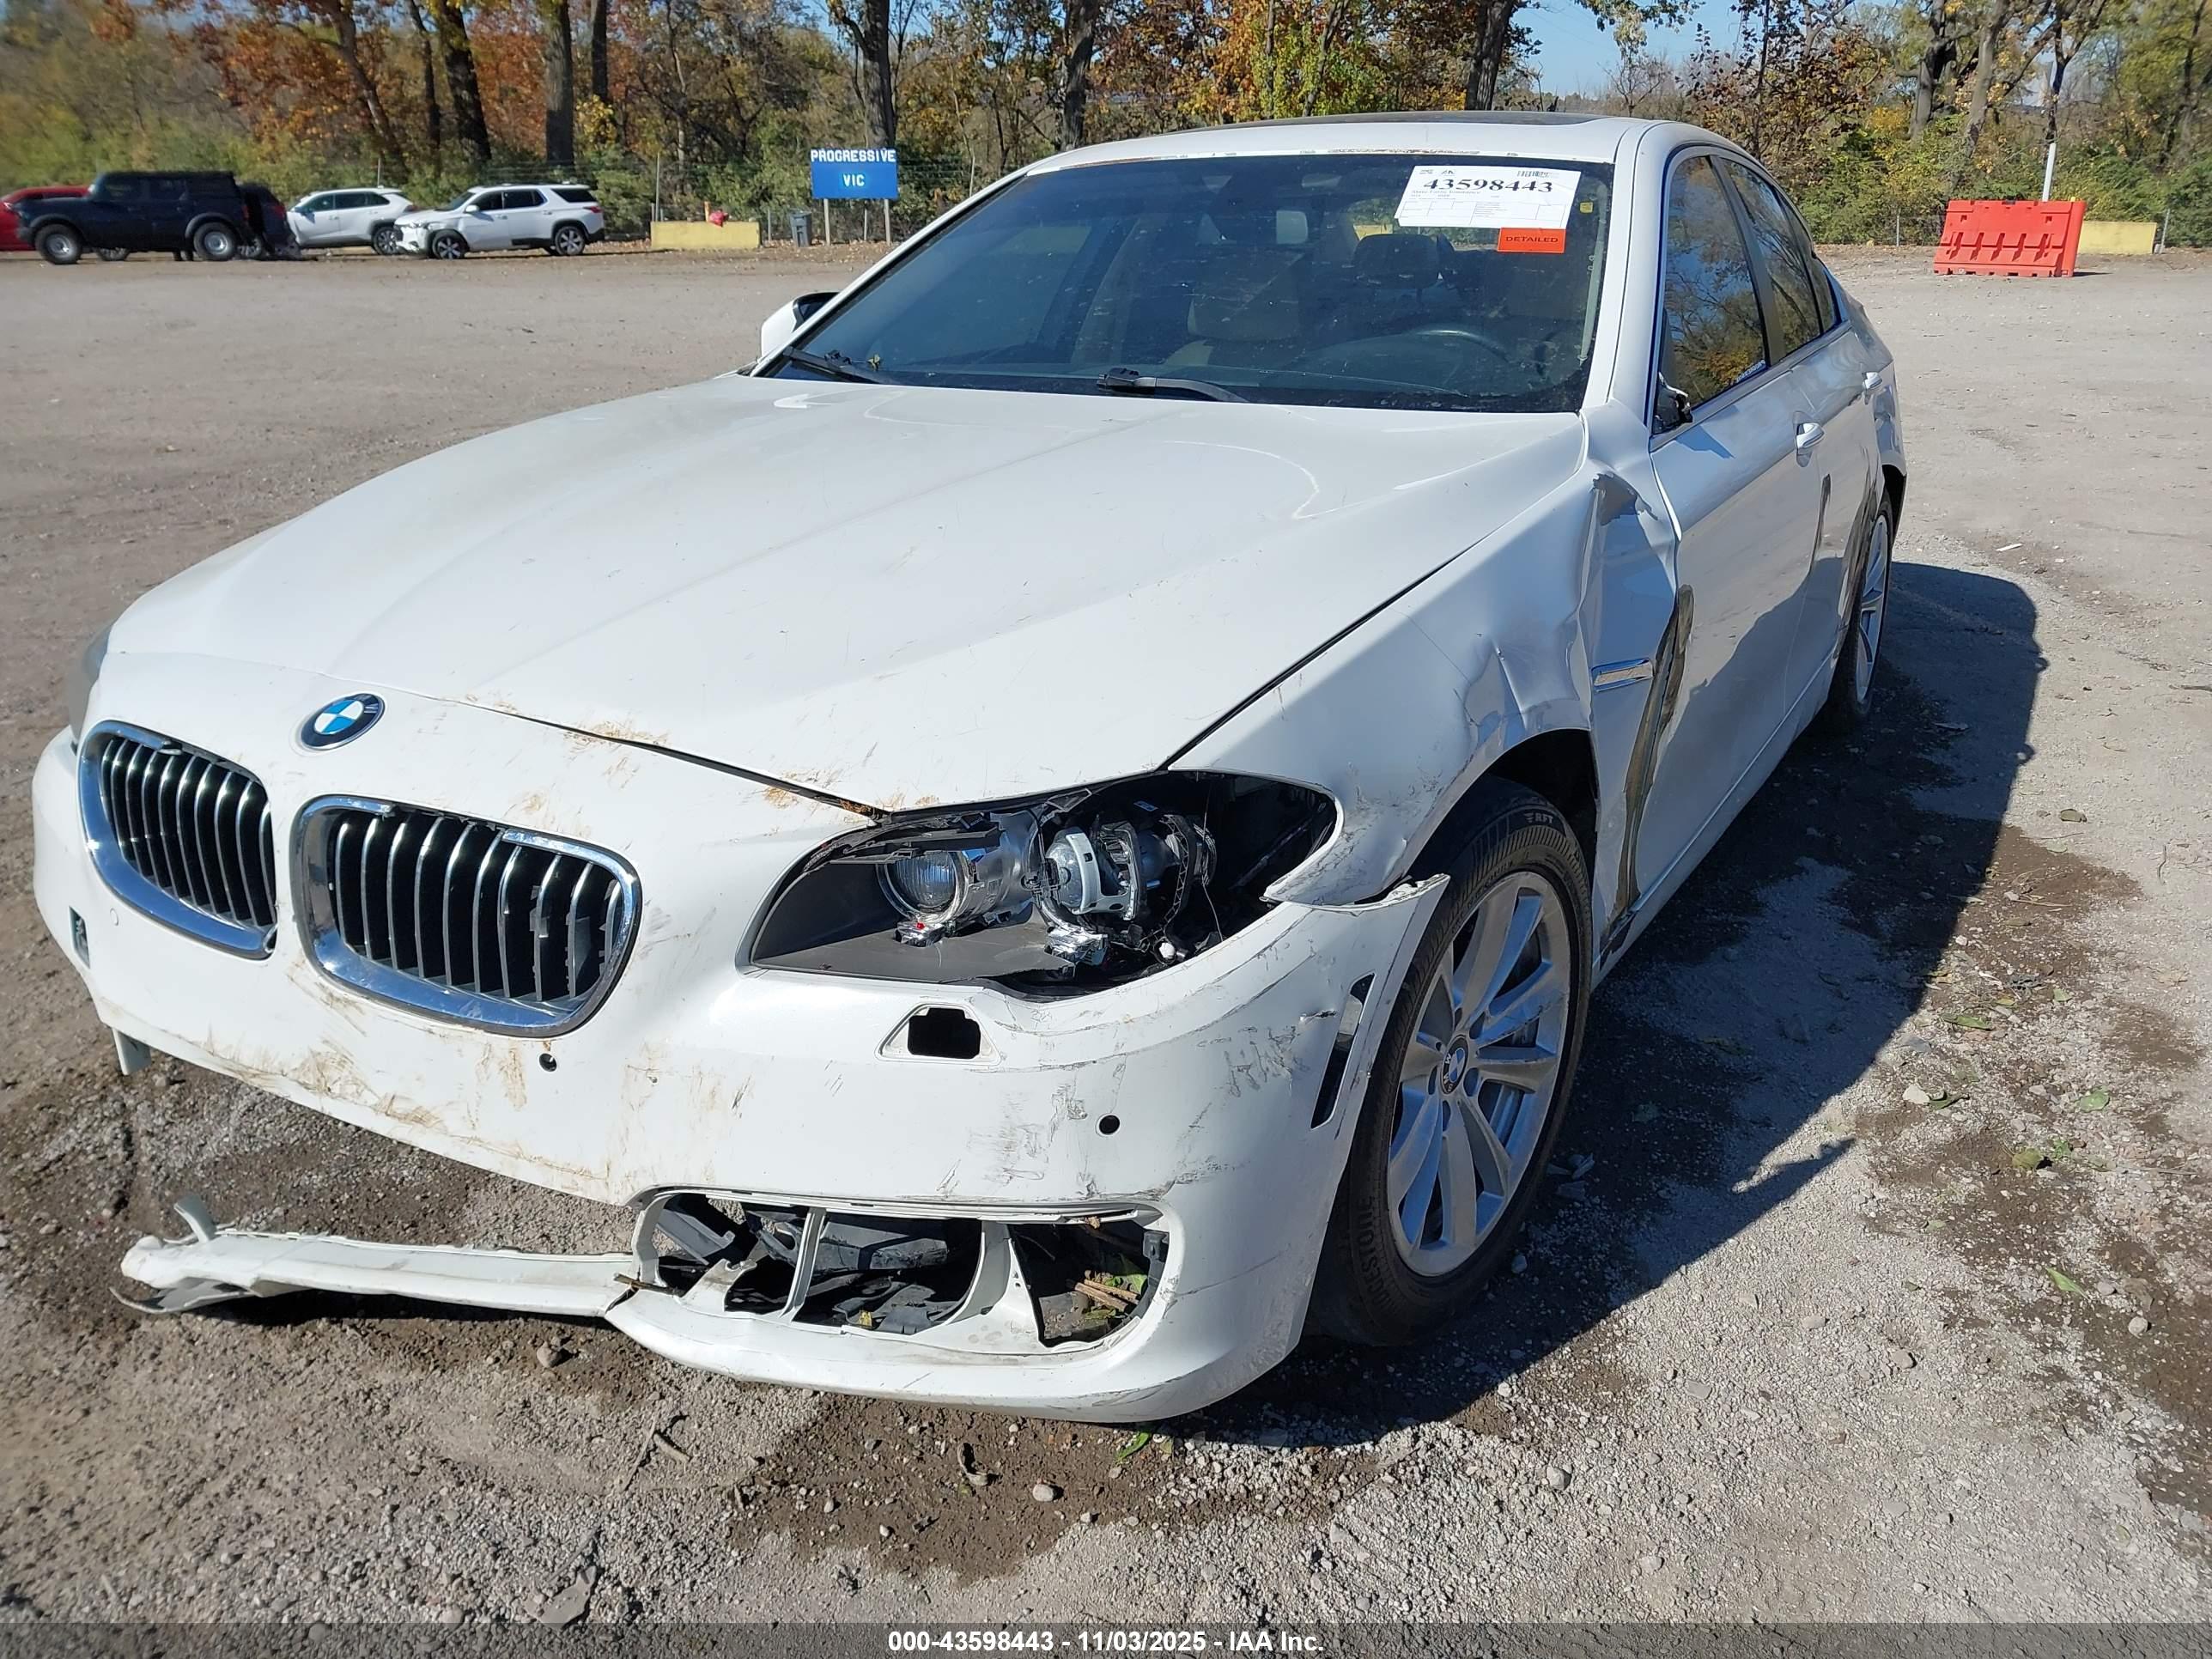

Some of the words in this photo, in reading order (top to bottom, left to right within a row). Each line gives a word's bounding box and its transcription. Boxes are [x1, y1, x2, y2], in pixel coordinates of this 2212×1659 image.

[811, 149, 896, 162] PROGRESSIVE
[843, 174, 865, 186] VIC
[1424, 179, 1553, 192] 43598443
